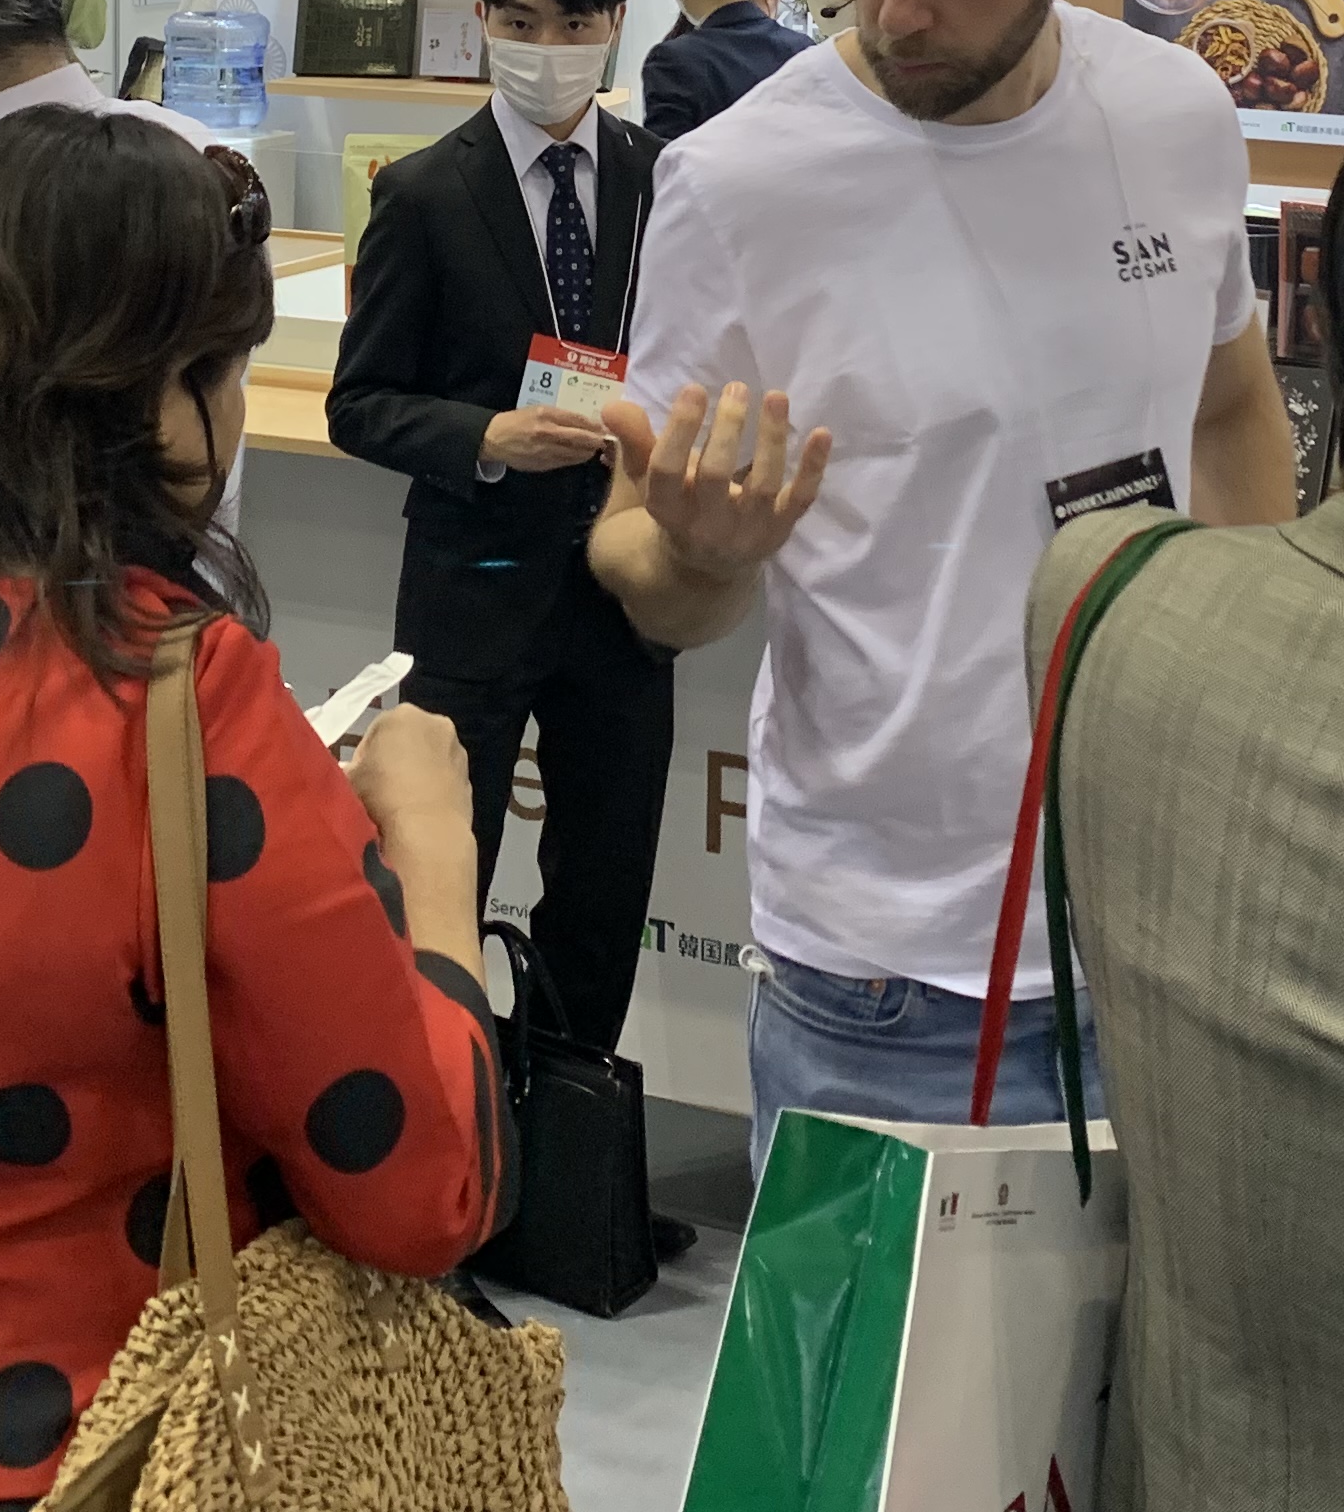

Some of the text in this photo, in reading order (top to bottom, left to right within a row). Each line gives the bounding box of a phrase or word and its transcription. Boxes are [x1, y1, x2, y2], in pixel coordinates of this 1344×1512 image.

[1113, 232, 1172, 265] SAN
[1119, 258, 1177, 282] COSME
[540, 371, 552, 388] 8
[490, 897, 531, 919] Servi
